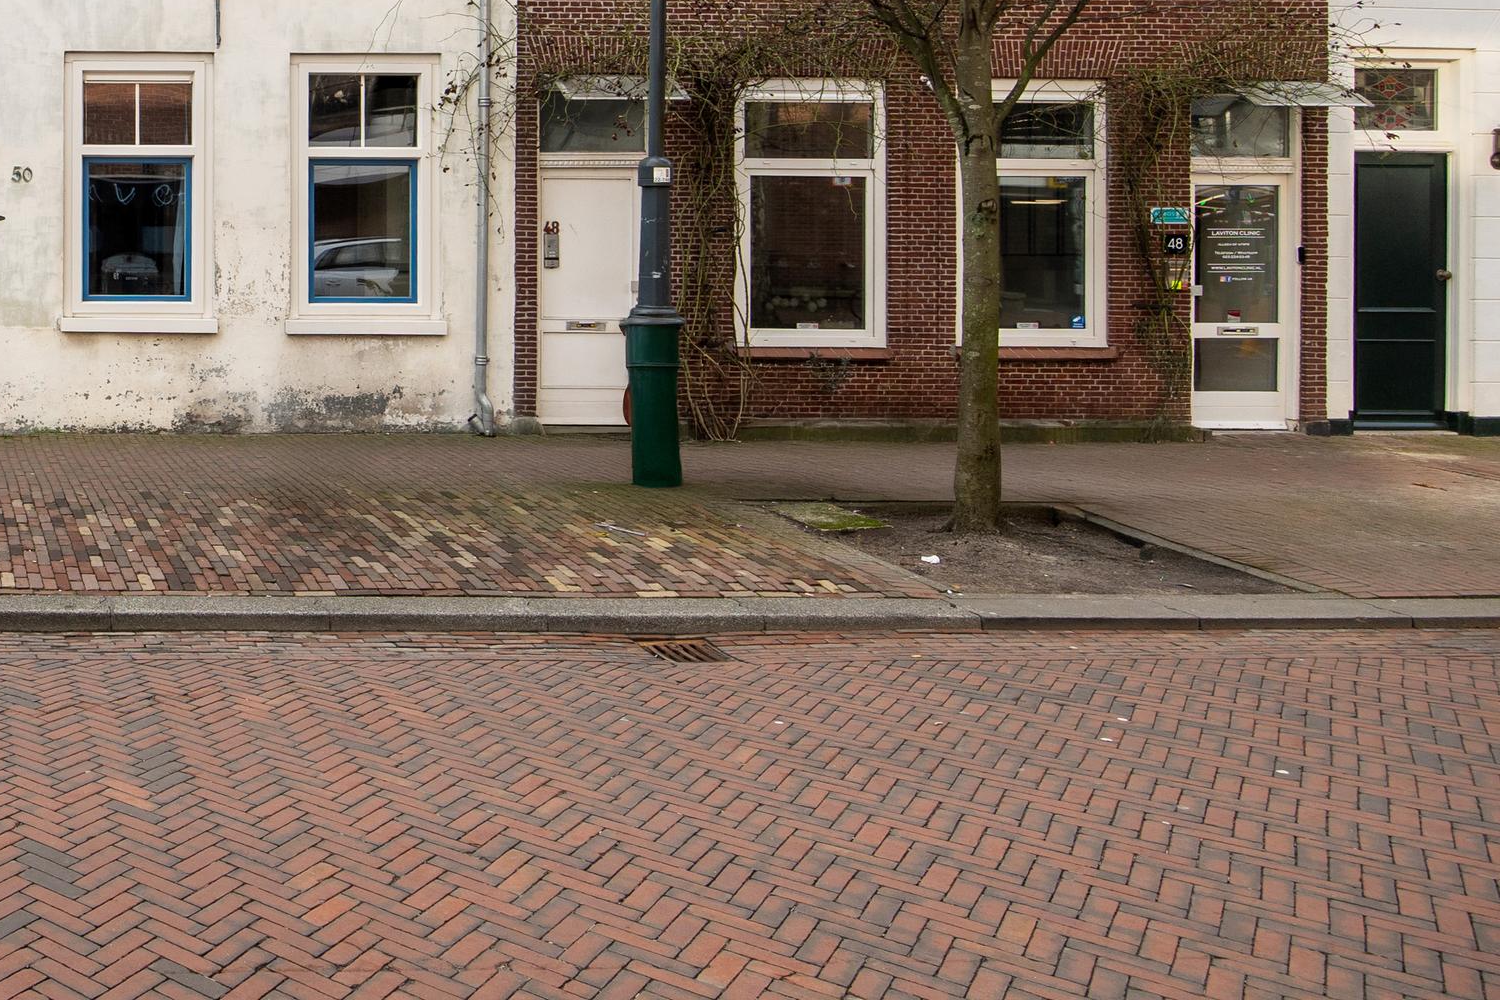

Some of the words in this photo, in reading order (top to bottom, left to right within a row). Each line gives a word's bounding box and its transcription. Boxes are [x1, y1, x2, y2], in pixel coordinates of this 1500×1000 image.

[11, 165, 33, 182] 50
[543, 220, 560, 235] 48
[1167, 238, 1184, 250] 48
